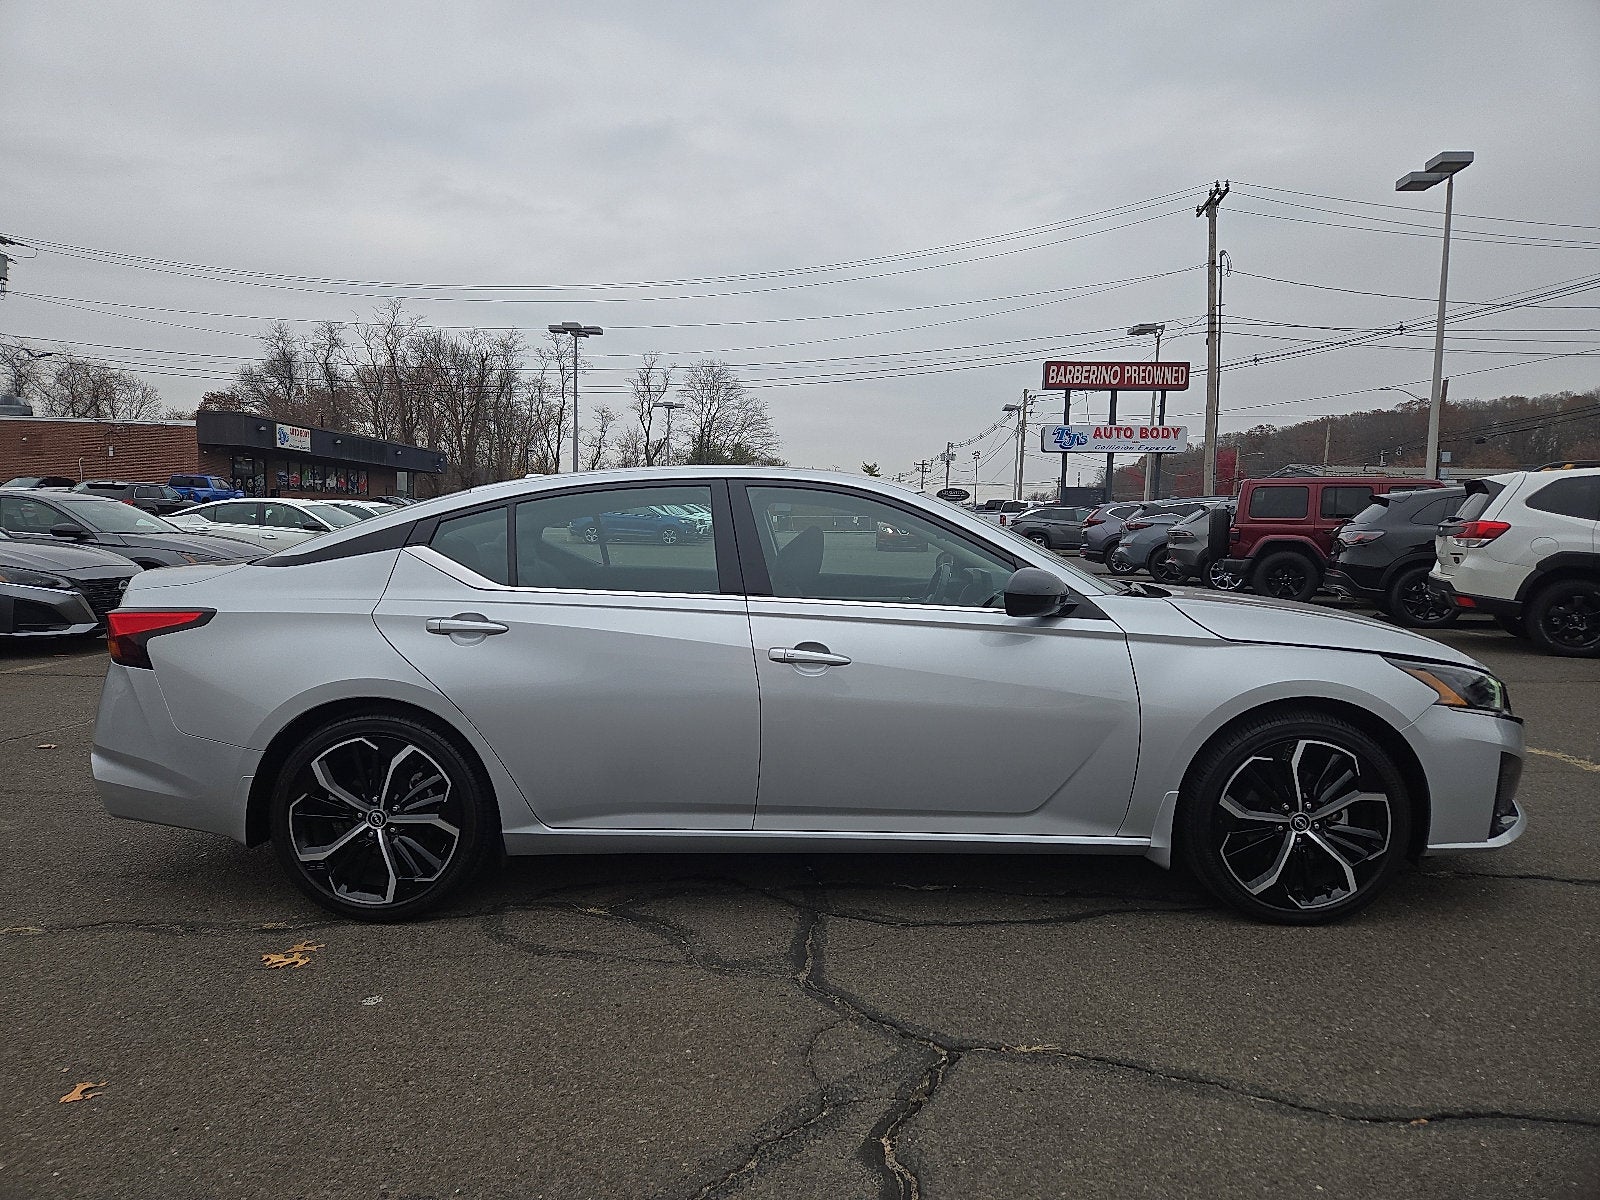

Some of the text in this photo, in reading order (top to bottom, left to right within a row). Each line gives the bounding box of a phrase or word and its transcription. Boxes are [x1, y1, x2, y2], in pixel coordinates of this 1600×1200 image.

[1048, 365, 1186, 385] BARBERINO PREOWNED
[1093, 426, 1181, 440] AUTO BODY
[1137, 444, 1177, 452] Experts
